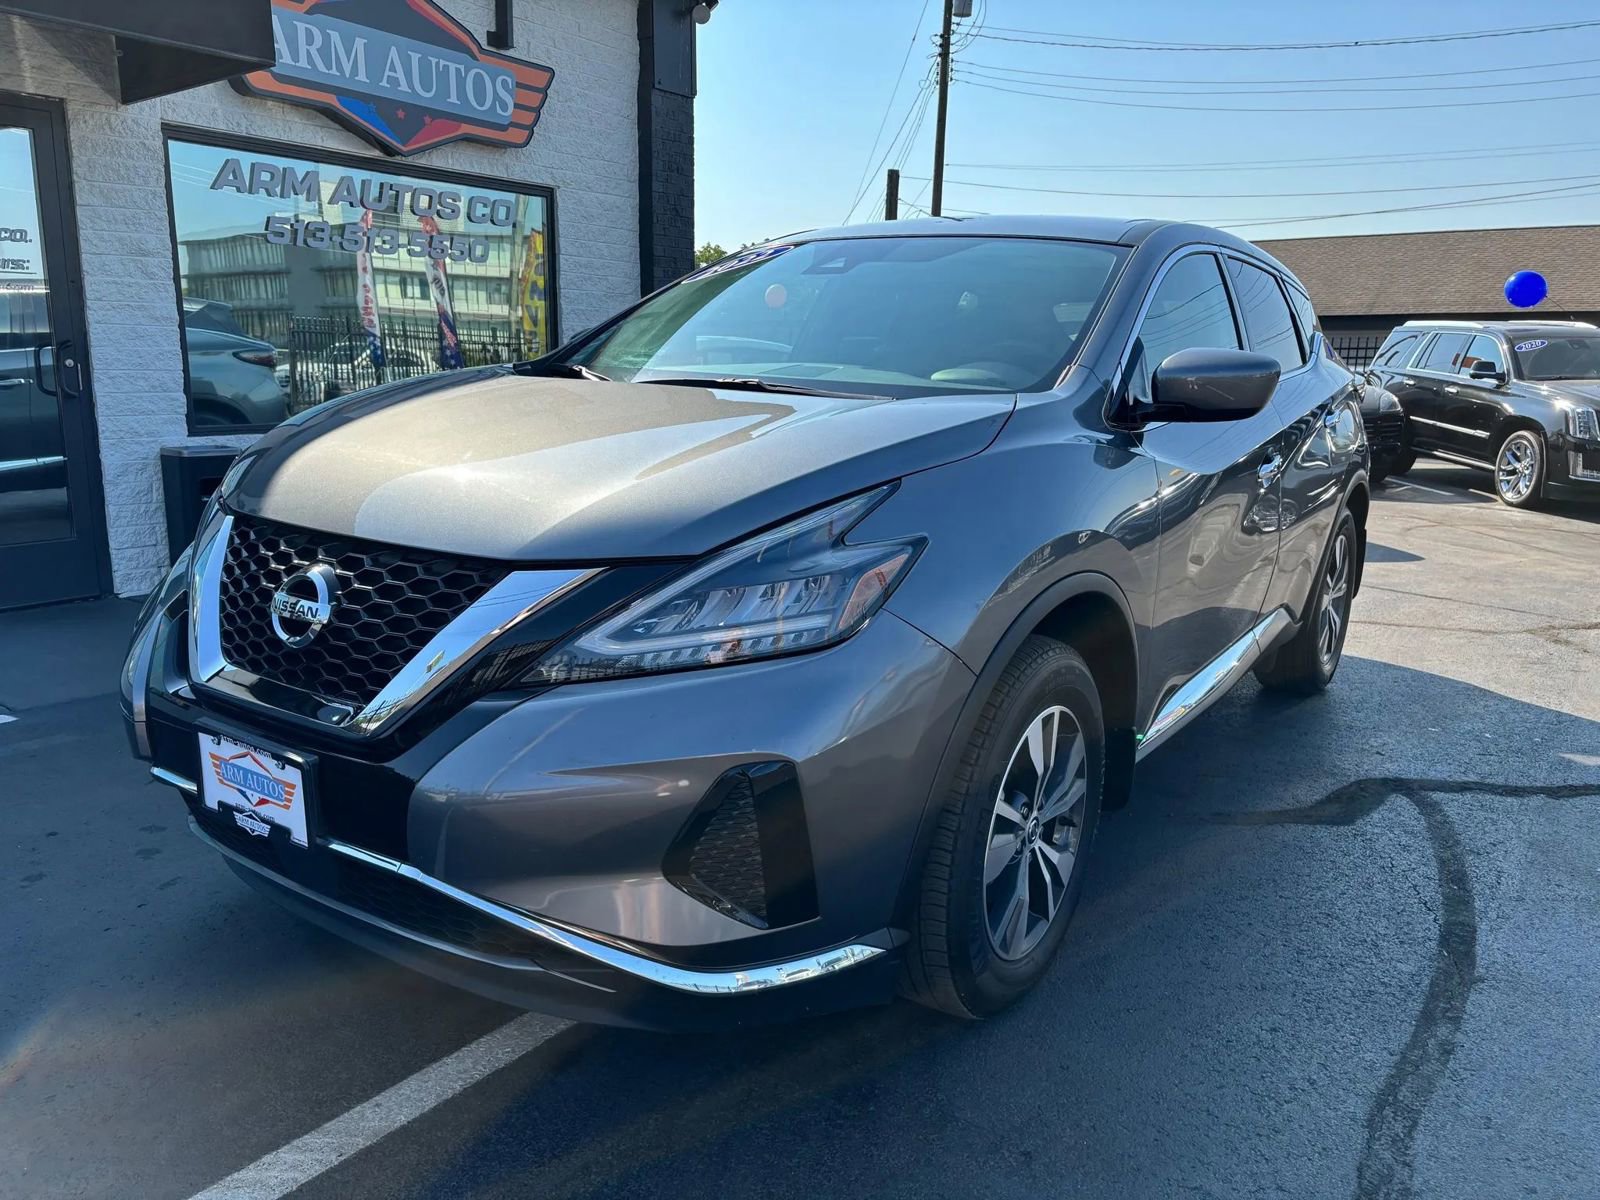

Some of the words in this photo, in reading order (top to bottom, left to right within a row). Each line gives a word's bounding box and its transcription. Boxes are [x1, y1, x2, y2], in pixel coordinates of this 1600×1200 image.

[272, 14, 370, 83] ARM
[379, 46, 514, 117] AUTOS
[209, 158, 321, 202] ARM
[327, 175, 462, 220] AUTOS
[1522, 340, 1541, 350] 2020
[273, 597, 319, 619] NISSAN
[221, 761, 245, 785] ARM
[246, 773, 285, 800] AUTOS
